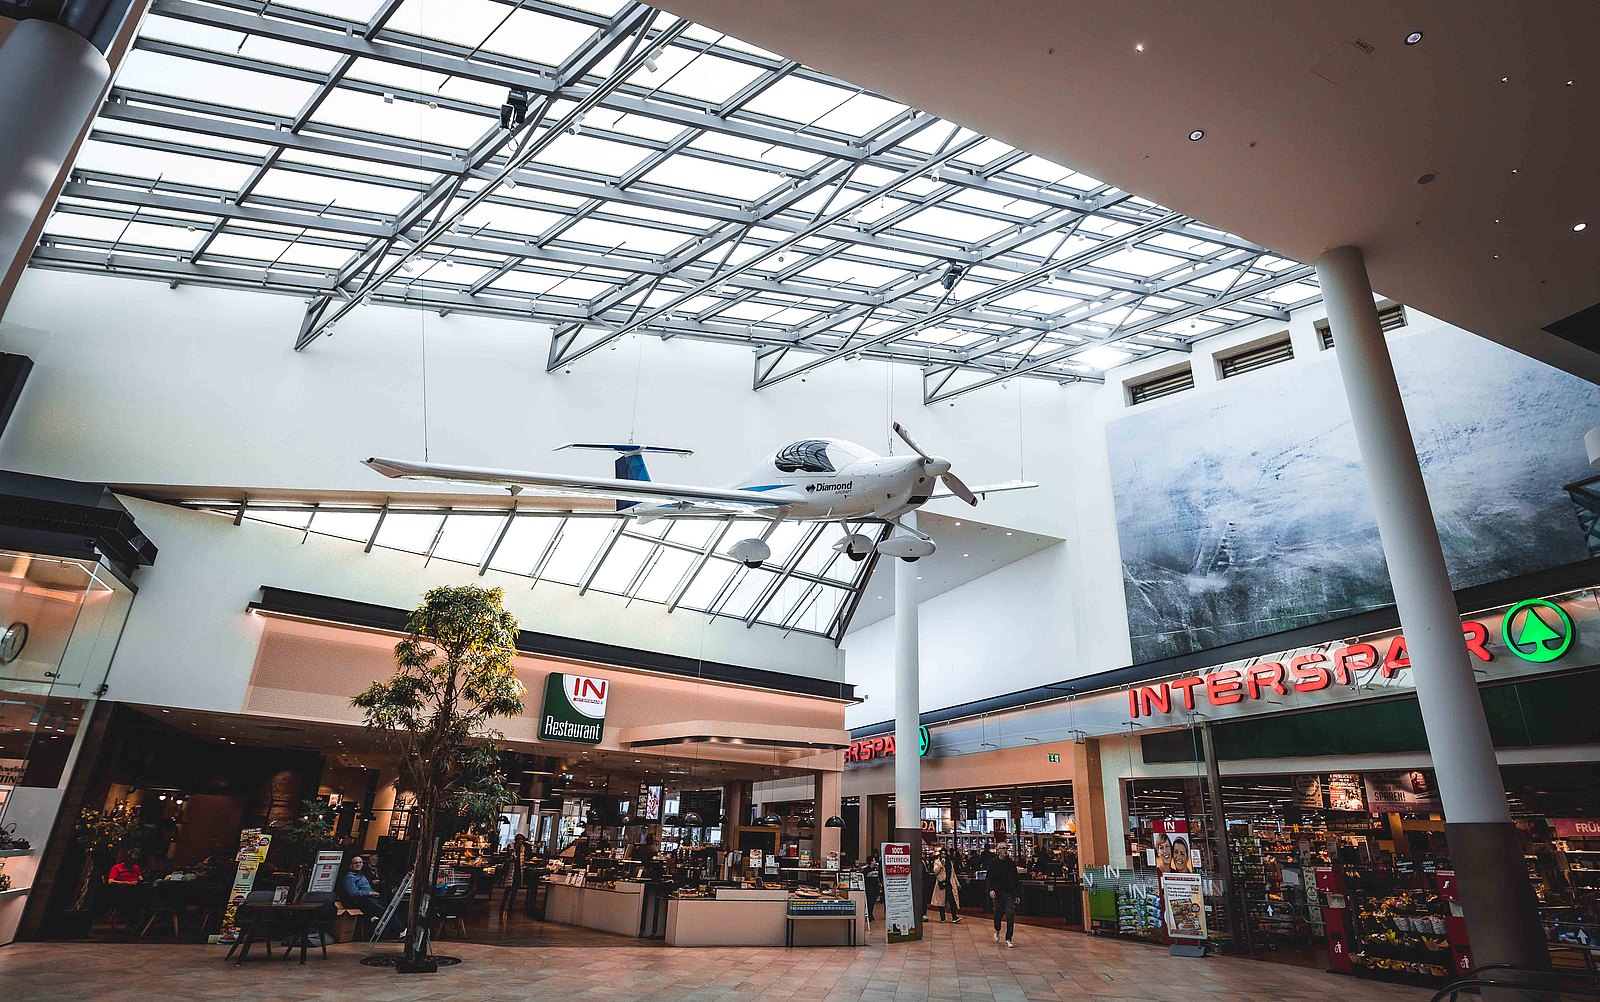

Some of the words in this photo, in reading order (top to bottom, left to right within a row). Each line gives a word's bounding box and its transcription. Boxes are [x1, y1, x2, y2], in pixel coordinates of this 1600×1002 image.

[815, 481, 853, 492] Diamond
[573, 677, 606, 700] IN
[544, 715, 600, 740] Restaurant
[1374, 791, 1406, 802] SPAREN!
[1164, 821, 1175, 830] IN
[891, 847, 904, 855] 100%
